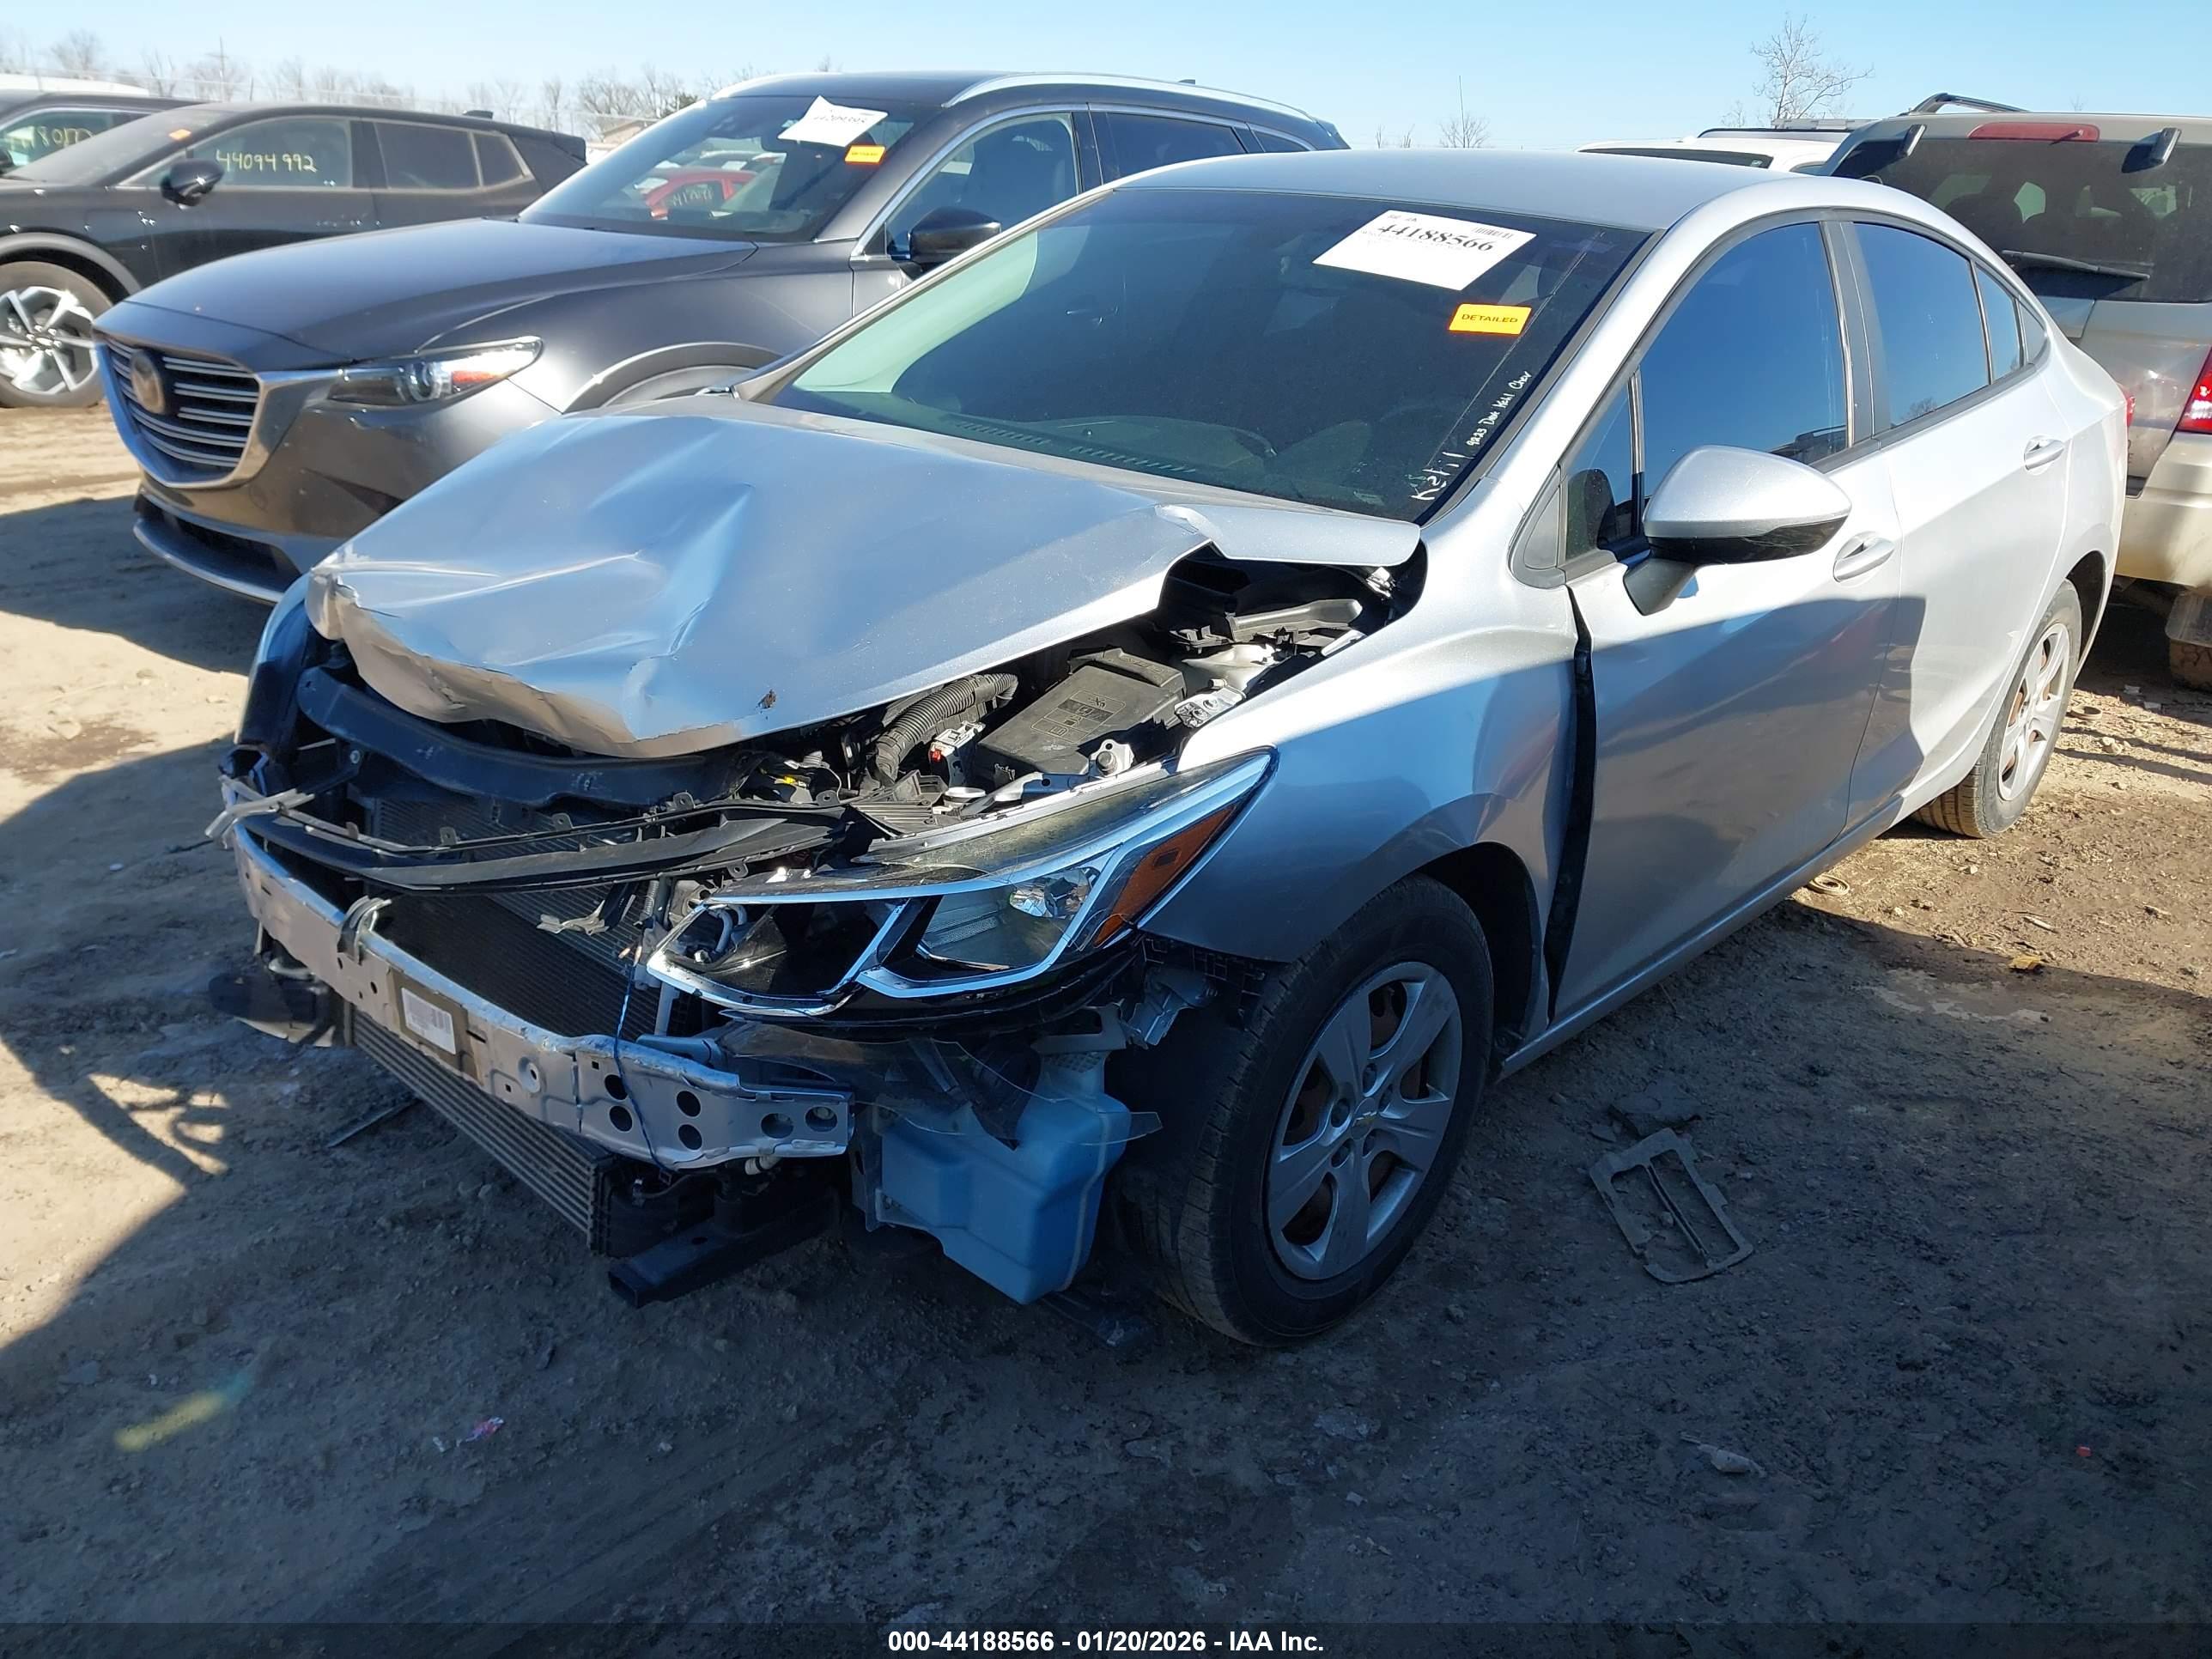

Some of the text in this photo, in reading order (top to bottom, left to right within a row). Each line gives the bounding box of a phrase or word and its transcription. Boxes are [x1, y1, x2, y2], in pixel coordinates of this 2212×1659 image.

[216, 149, 318, 173] 44094 992
[1377, 224, 1494, 252] 44188566
[1462, 313, 1518, 323] DETAILED
